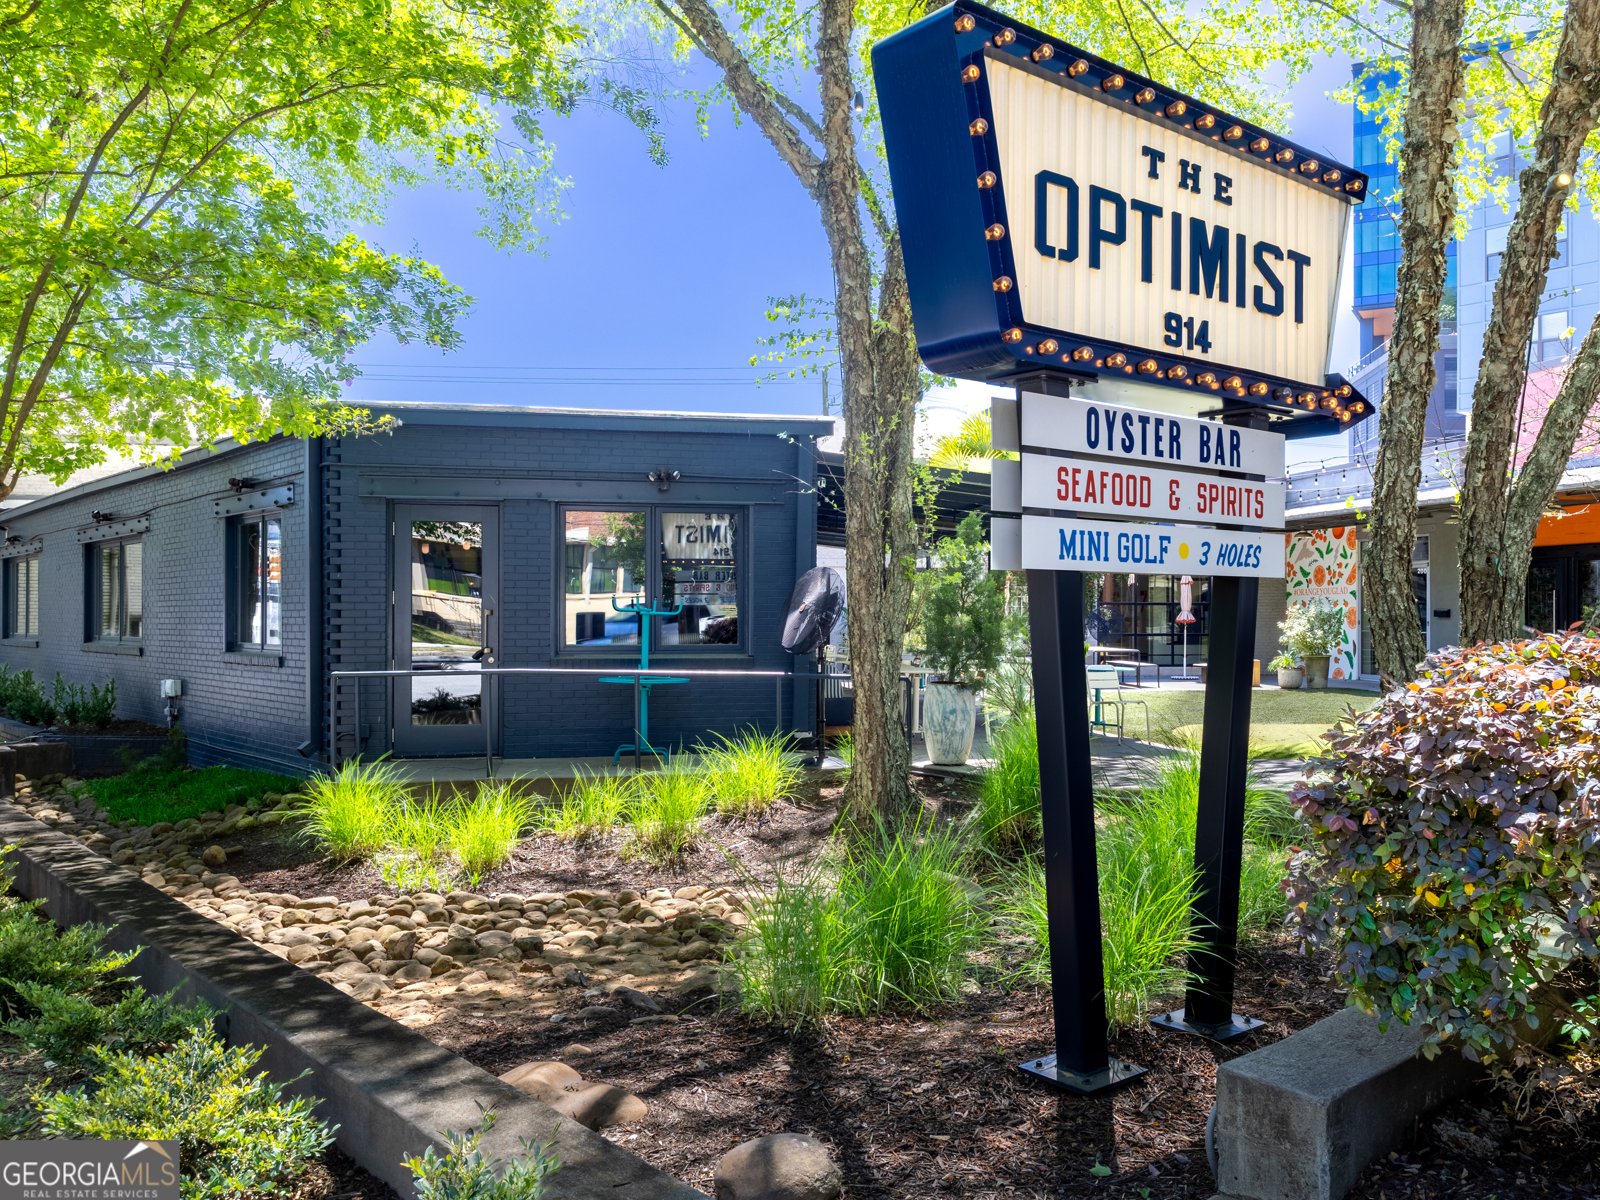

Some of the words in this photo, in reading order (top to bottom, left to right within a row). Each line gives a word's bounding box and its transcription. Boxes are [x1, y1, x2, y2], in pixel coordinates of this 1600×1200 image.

[1141, 145, 1233, 206] THE
[1034, 169, 1311, 324] OPTIMIST
[1164, 311, 1212, 354] 914
[1086, 406, 1181, 460] OYSTER
[1199, 424, 1241, 468] BAR
[1057, 466, 1151, 508] SEAFOOD
[1169, 479, 1181, 511] &
[1197, 482, 1264, 519] SPIRITS
[1058, 528, 1110, 562] MINI
[1117, 532, 1172, 565] GOLF
[1199, 541, 1210, 566] 3
[1216, 543, 1262, 569] HOLES
[1293, 587, 1349, 597] #ORANGEYOUGLAD
